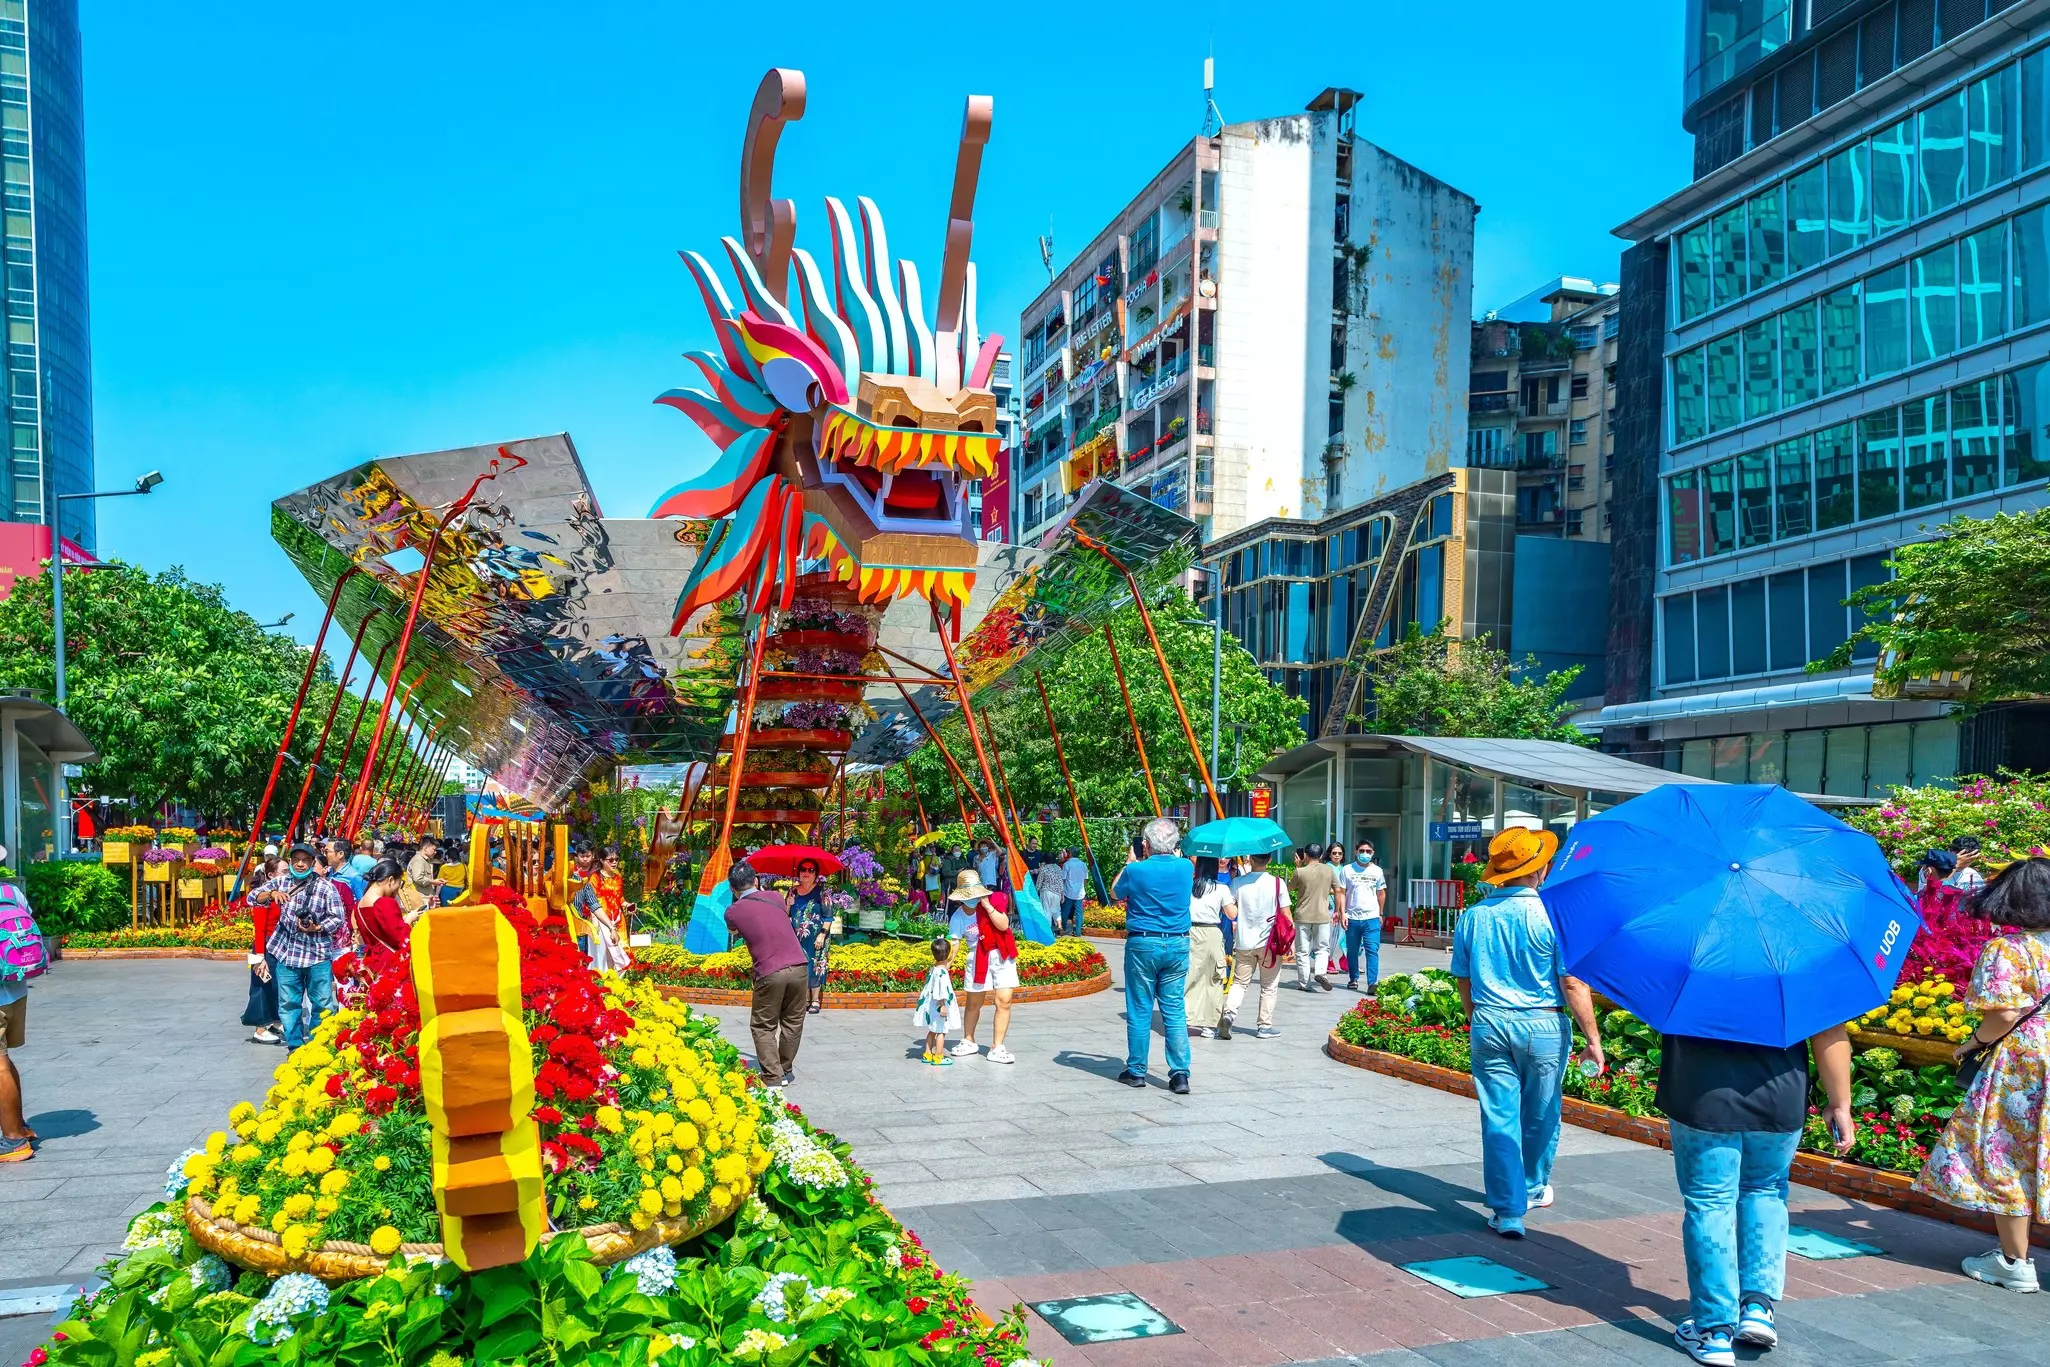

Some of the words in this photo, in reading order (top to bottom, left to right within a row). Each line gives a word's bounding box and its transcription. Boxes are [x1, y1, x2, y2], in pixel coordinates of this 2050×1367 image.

[1126, 280, 1147, 307] POCHA
[1075, 330, 1088, 352] THE
[1087, 310, 1112, 342] LETTER
[1133, 371, 1178, 411] Carlsberg
[1879, 919, 1901, 956] UOB
